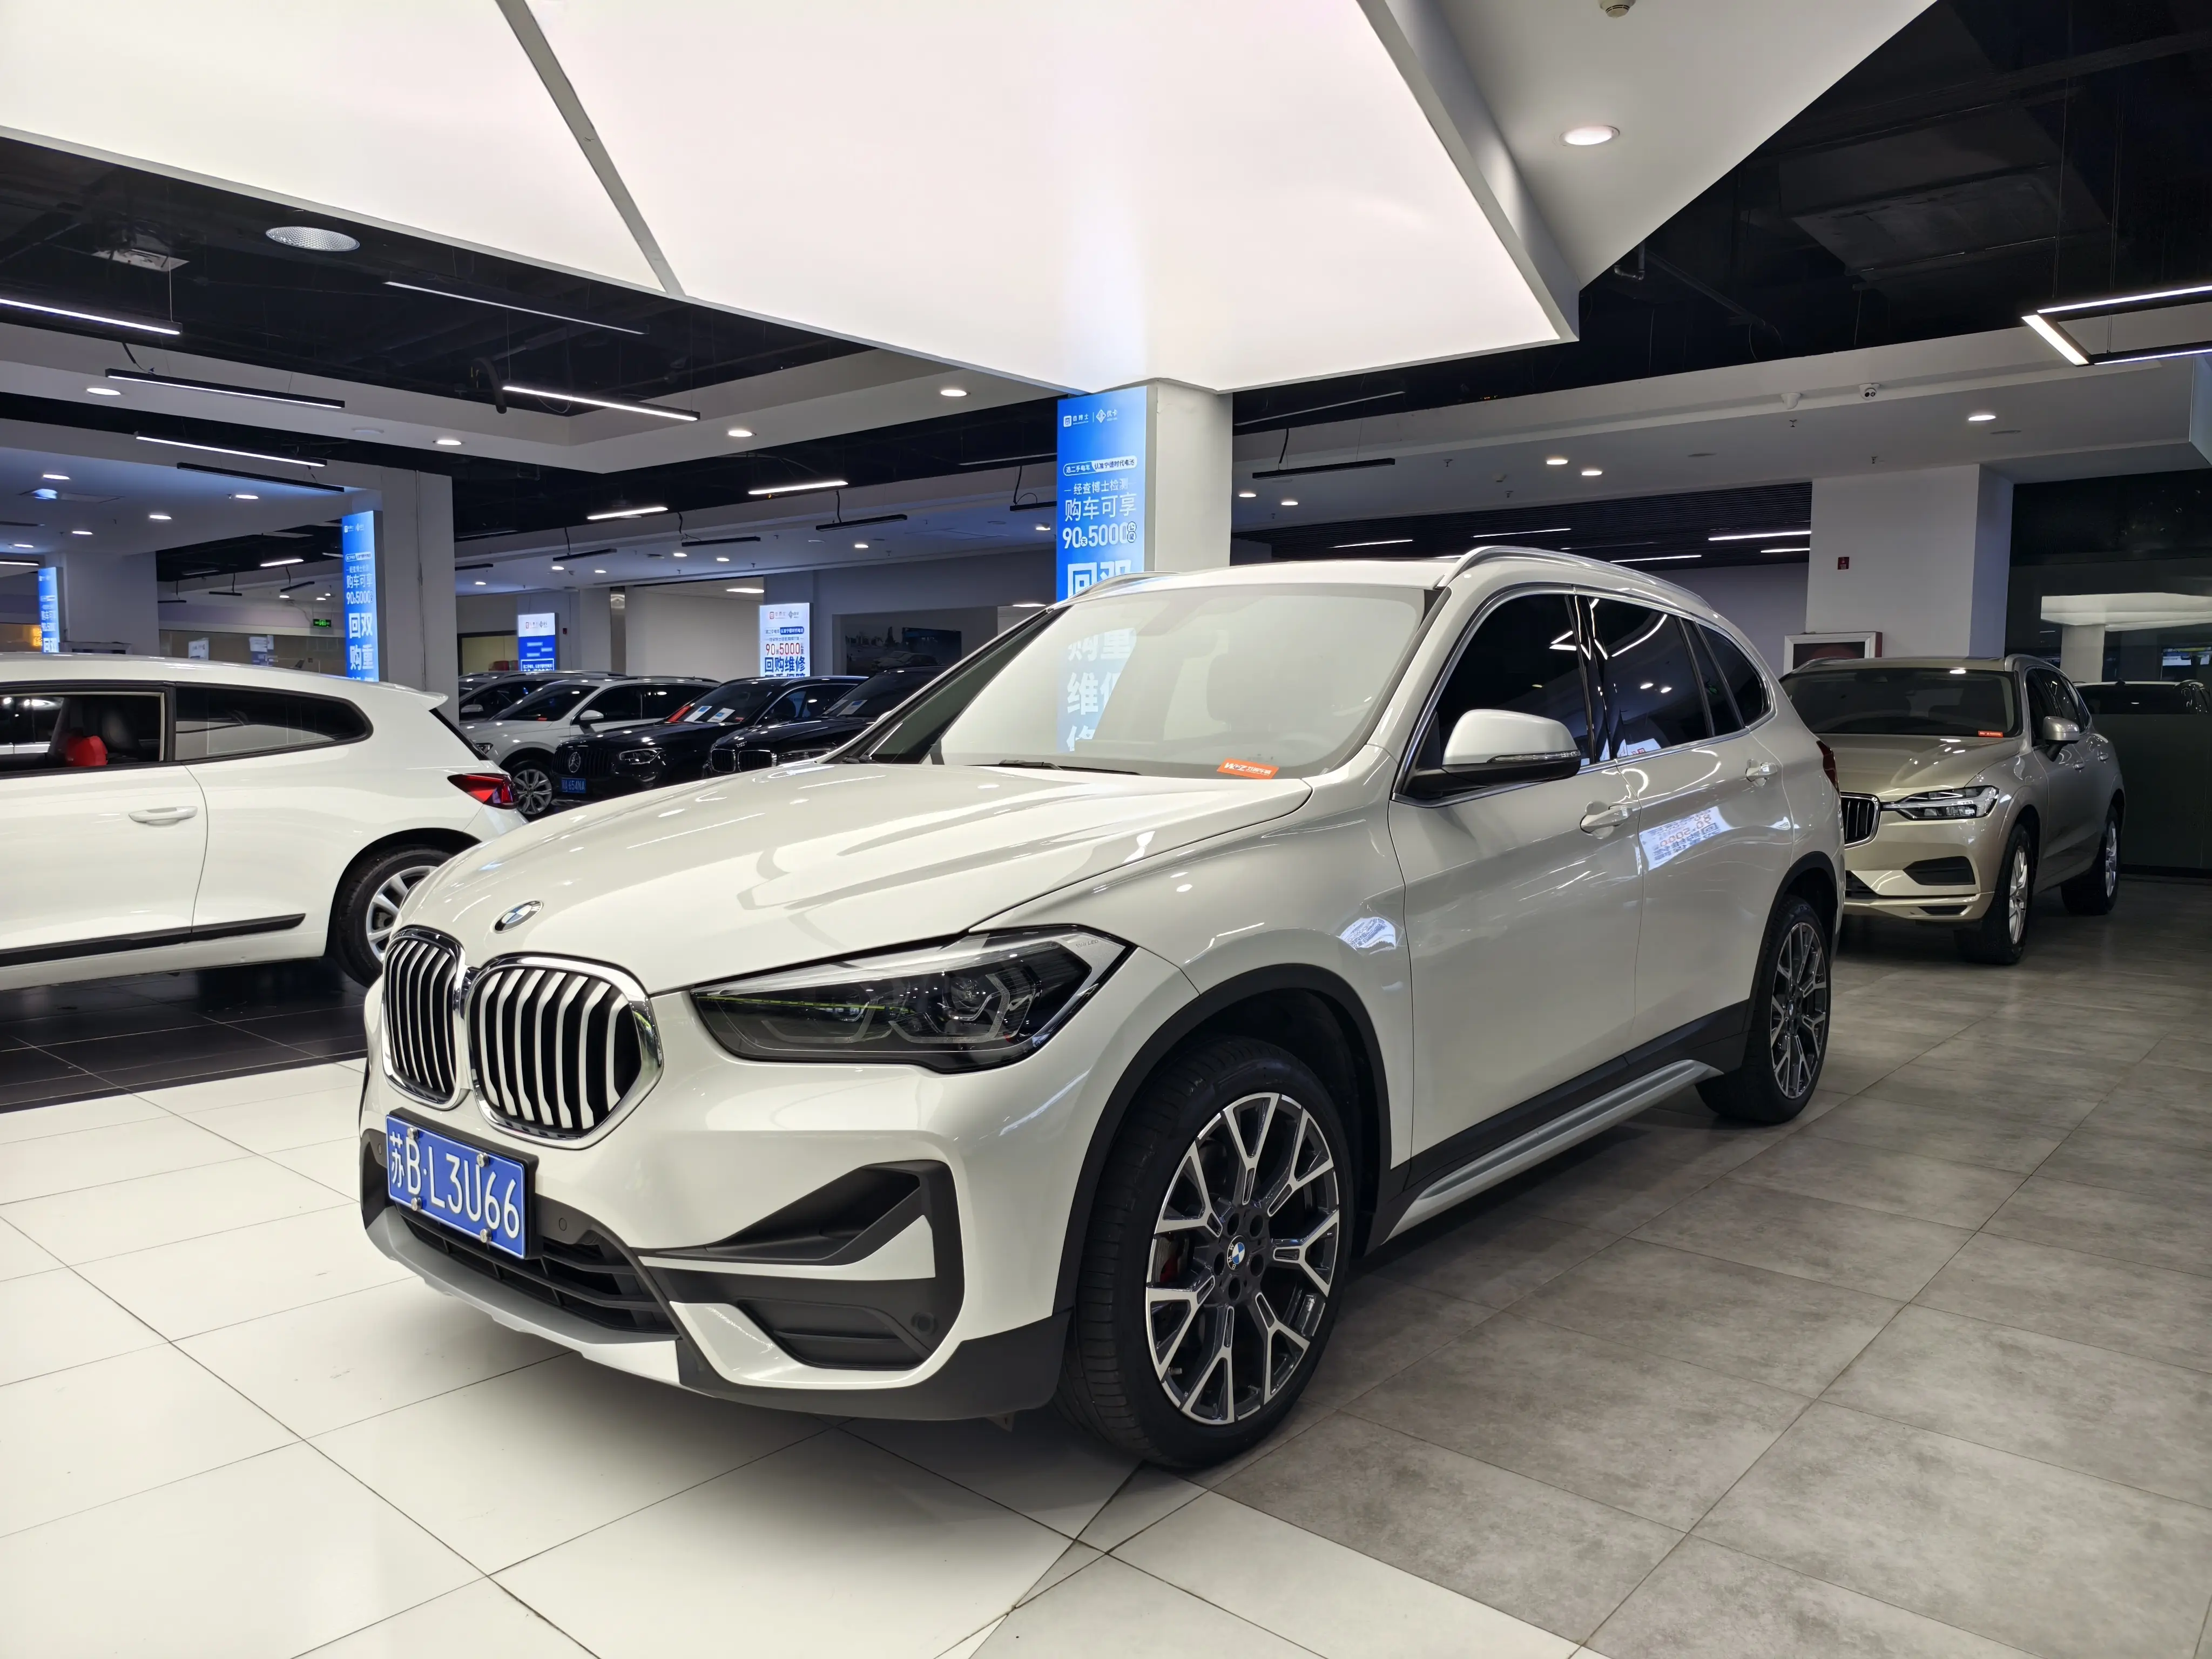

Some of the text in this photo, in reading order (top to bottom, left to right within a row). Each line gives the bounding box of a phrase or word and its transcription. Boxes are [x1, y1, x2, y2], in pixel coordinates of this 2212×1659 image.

[1065, 493, 1137, 522] 购车可享
[765, 656, 805, 672] 回购维修
